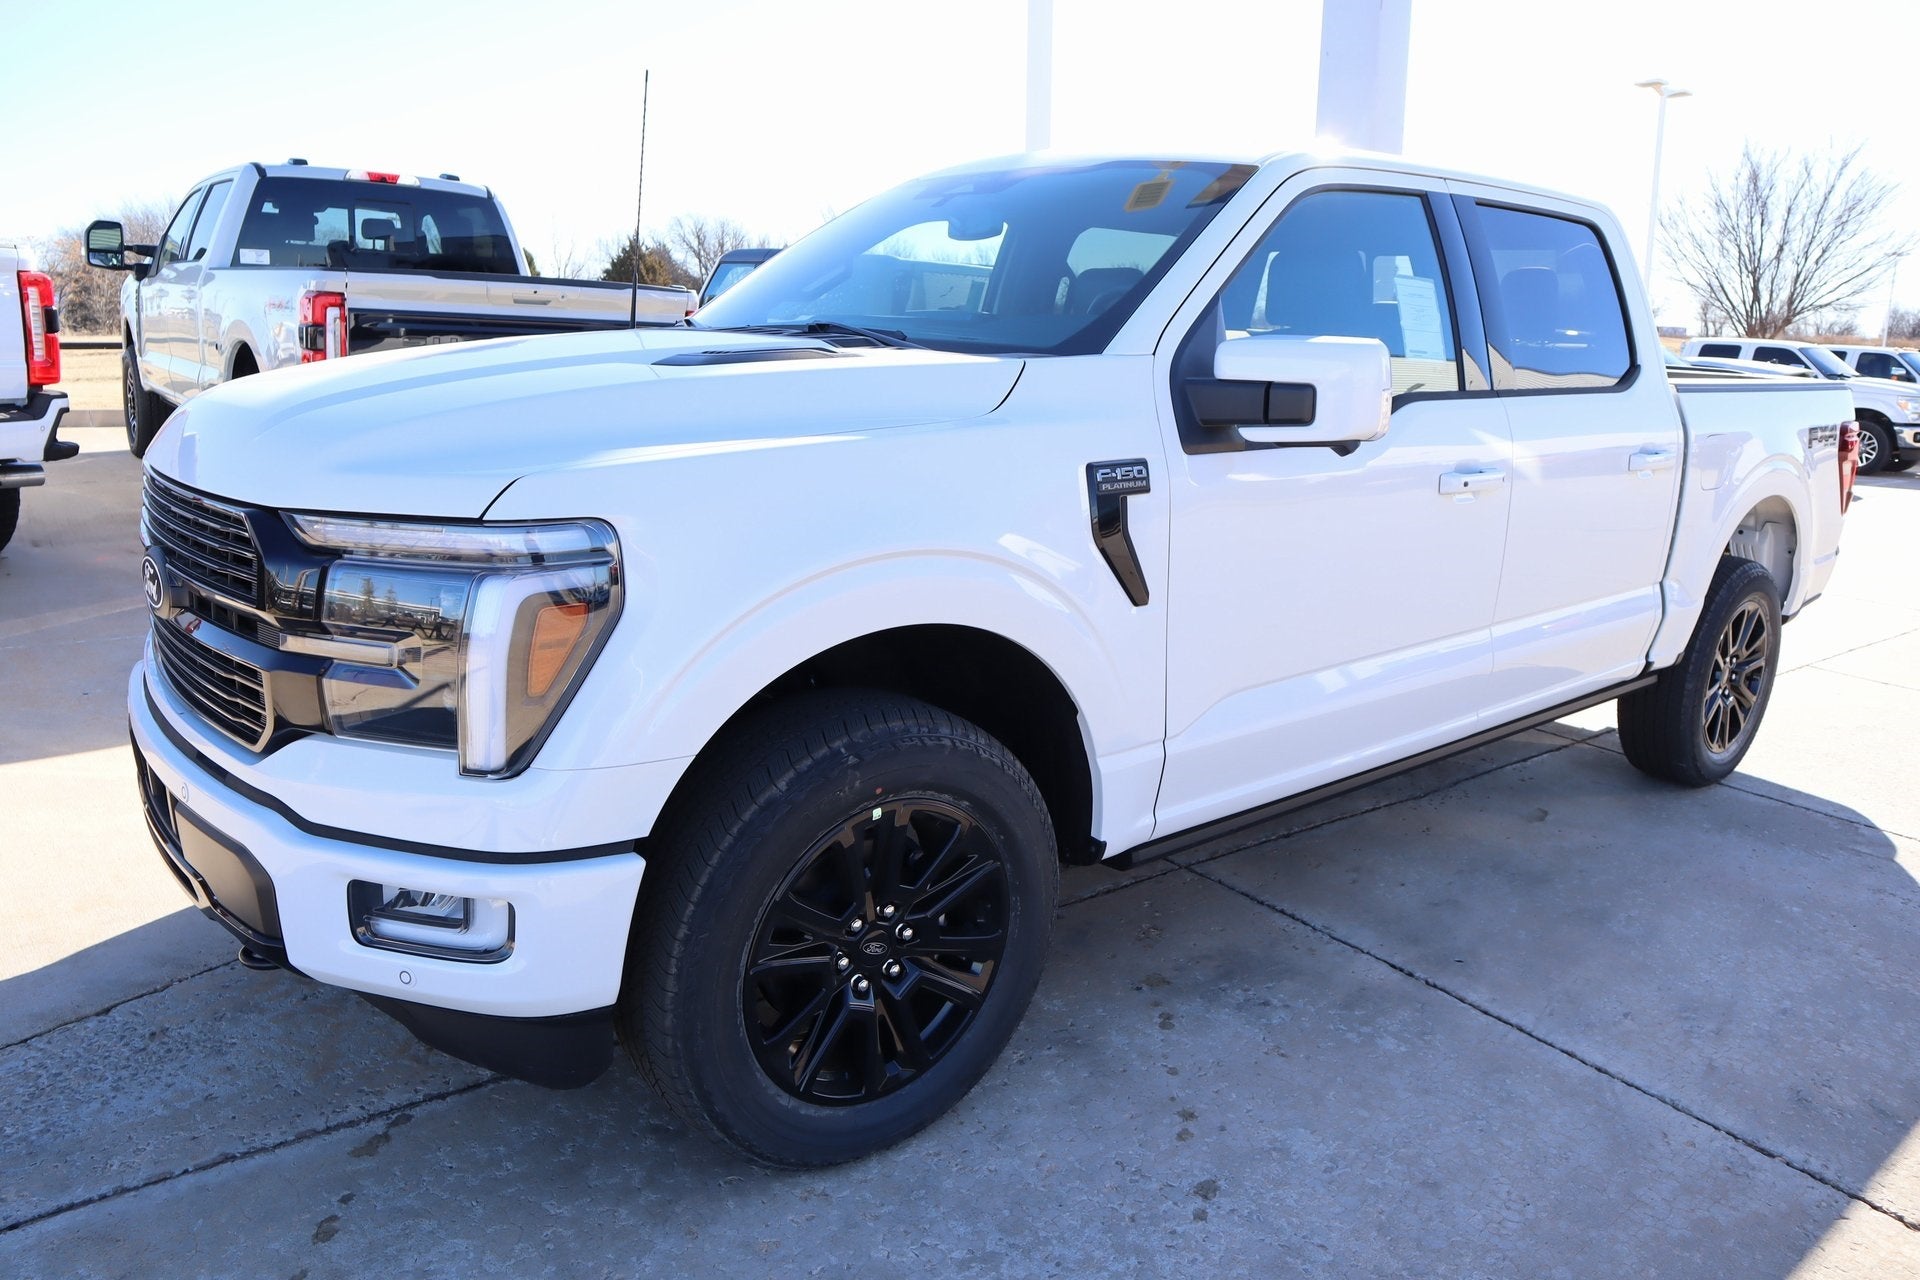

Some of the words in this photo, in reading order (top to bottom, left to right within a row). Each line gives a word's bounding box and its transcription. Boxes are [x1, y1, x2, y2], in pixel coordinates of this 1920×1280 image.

[1096, 465, 1147, 482] F-150
[1102, 480, 1147, 490] PLATINUM
[143, 561, 159, 602] Ford
[865, 943, 885, 953] Ford
